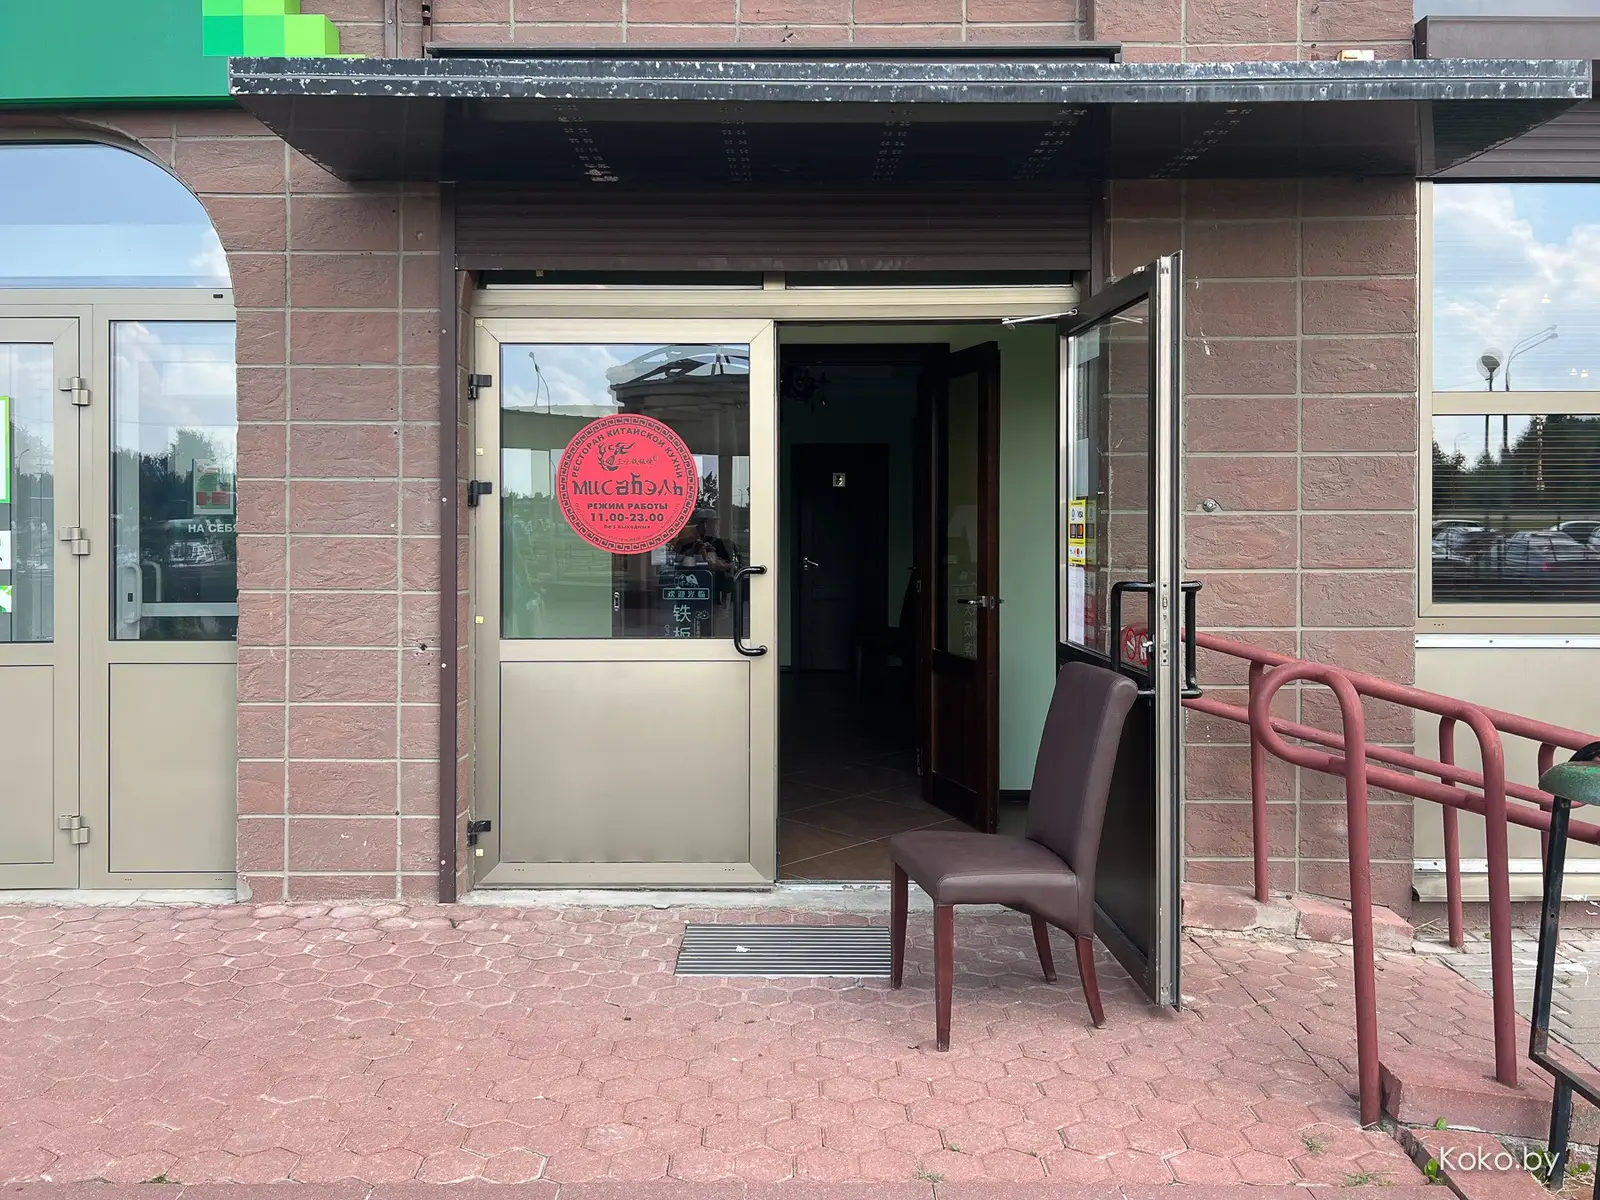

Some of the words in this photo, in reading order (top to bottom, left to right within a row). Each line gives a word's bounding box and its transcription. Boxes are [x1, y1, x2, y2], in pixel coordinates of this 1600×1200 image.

[571, 434, 605, 478] РЕСТОРАН
[606, 427, 666, 448] КИТАЙСКОЙ
[664, 447, 684, 479] КУХНИ
[587, 502, 625, 510] РЕЖИМ
[627, 502, 668, 510] РАБОТЫ
[590, 513, 664, 522] 11.00-23.00
[187, 523, 205, 533] НА
